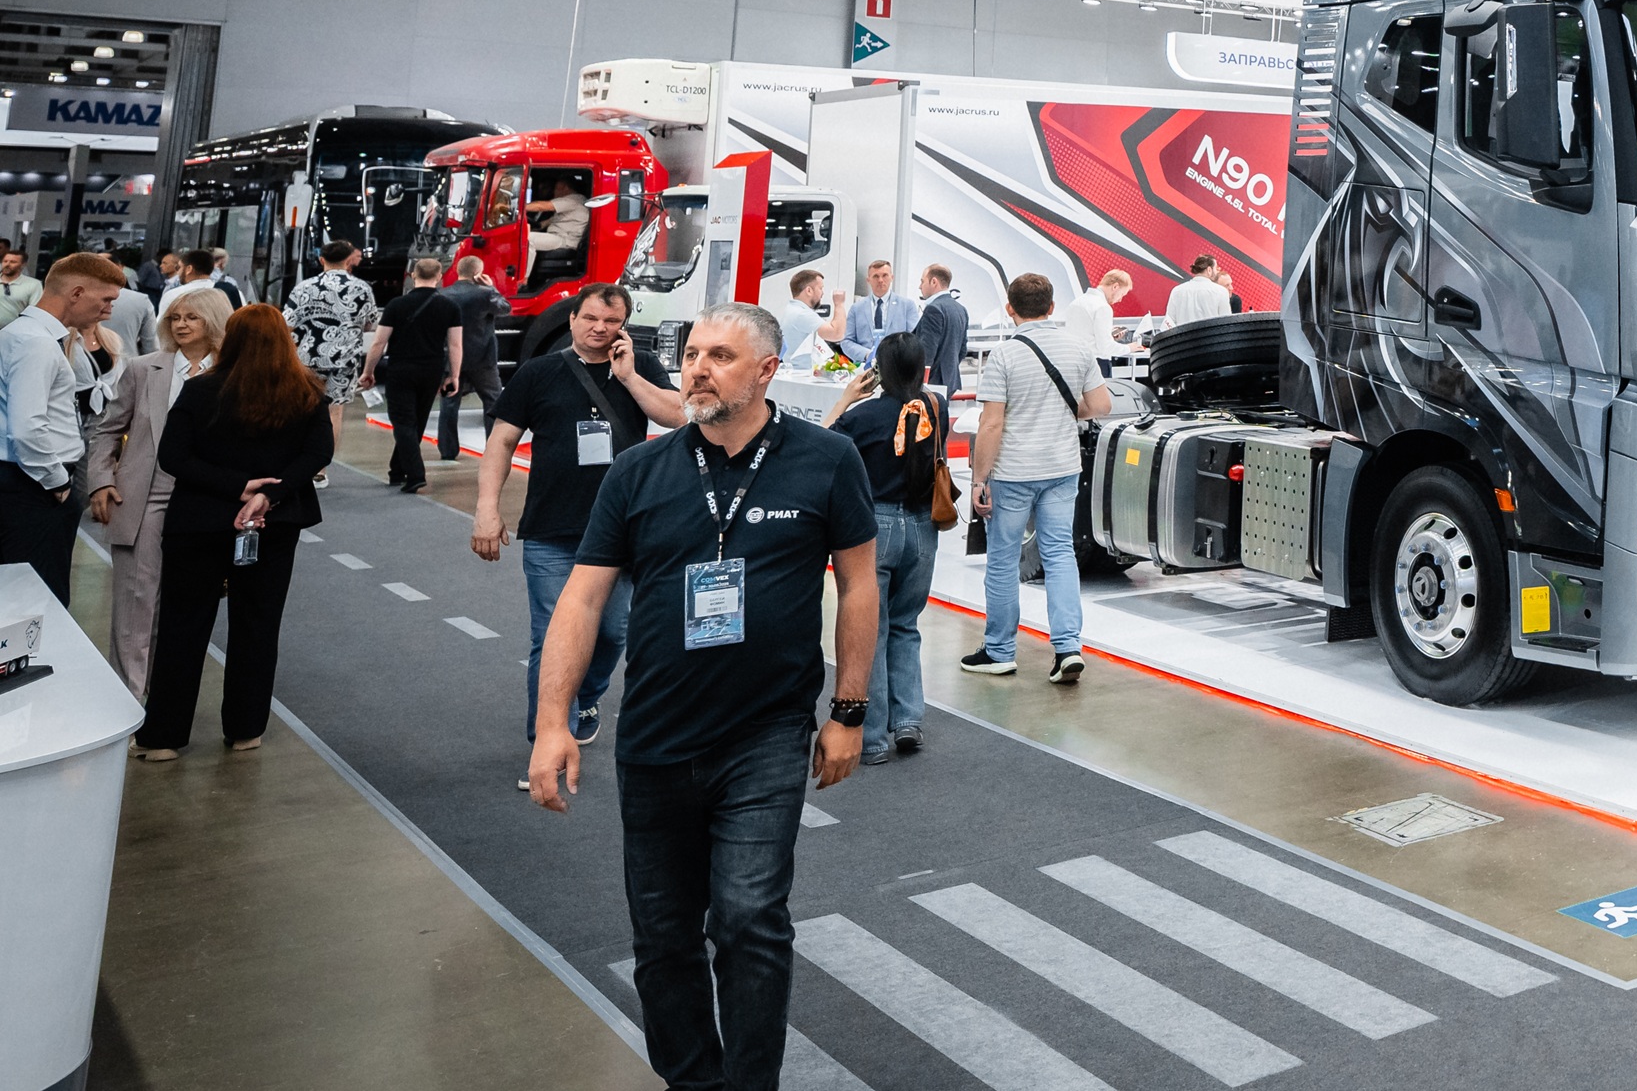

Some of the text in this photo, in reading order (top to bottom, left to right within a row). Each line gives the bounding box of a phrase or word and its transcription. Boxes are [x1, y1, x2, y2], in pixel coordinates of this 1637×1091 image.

[1218, 51, 1297, 70] ЗАПРАВЬС
[47, 99, 162, 127] KAMAZ
[928, 105, 1000, 116] www.jacrus.ru
[1191, 134, 1274, 206] N90
[1185, 166, 1226, 199] ENGINE
[1224, 194, 1246, 214] 4.5L
[1247, 207, 1278, 236] TOTAL
[766, 509, 800, 520] РИАТ
